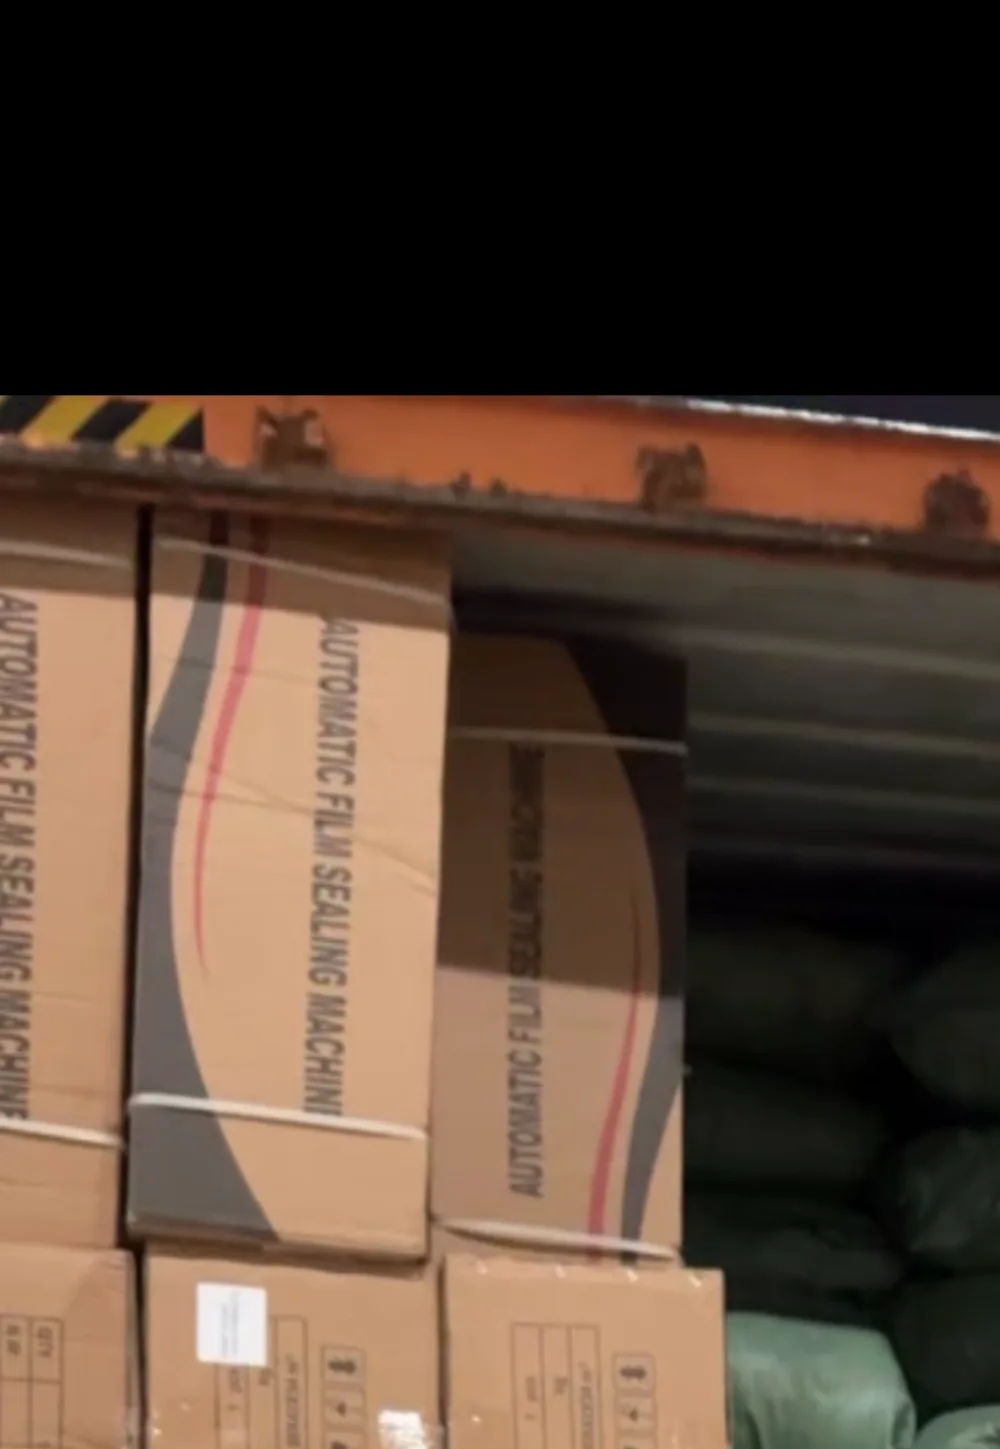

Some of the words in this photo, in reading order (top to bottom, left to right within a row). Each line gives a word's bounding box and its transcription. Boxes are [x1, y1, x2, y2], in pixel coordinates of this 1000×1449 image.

[0, 594, 38, 770] AUTOMATIC
[317, 617, 359, 784] AUTOMATIC
[0, 778, 36, 848] FILM
[313, 792, 354, 859] FILM
[0, 854, 35, 980] SEALING
[308, 864, 352, 985] SEALING
[508, 985, 542, 1045] FILM
[507, 1052, 543, 1199] AUTOMATIC
